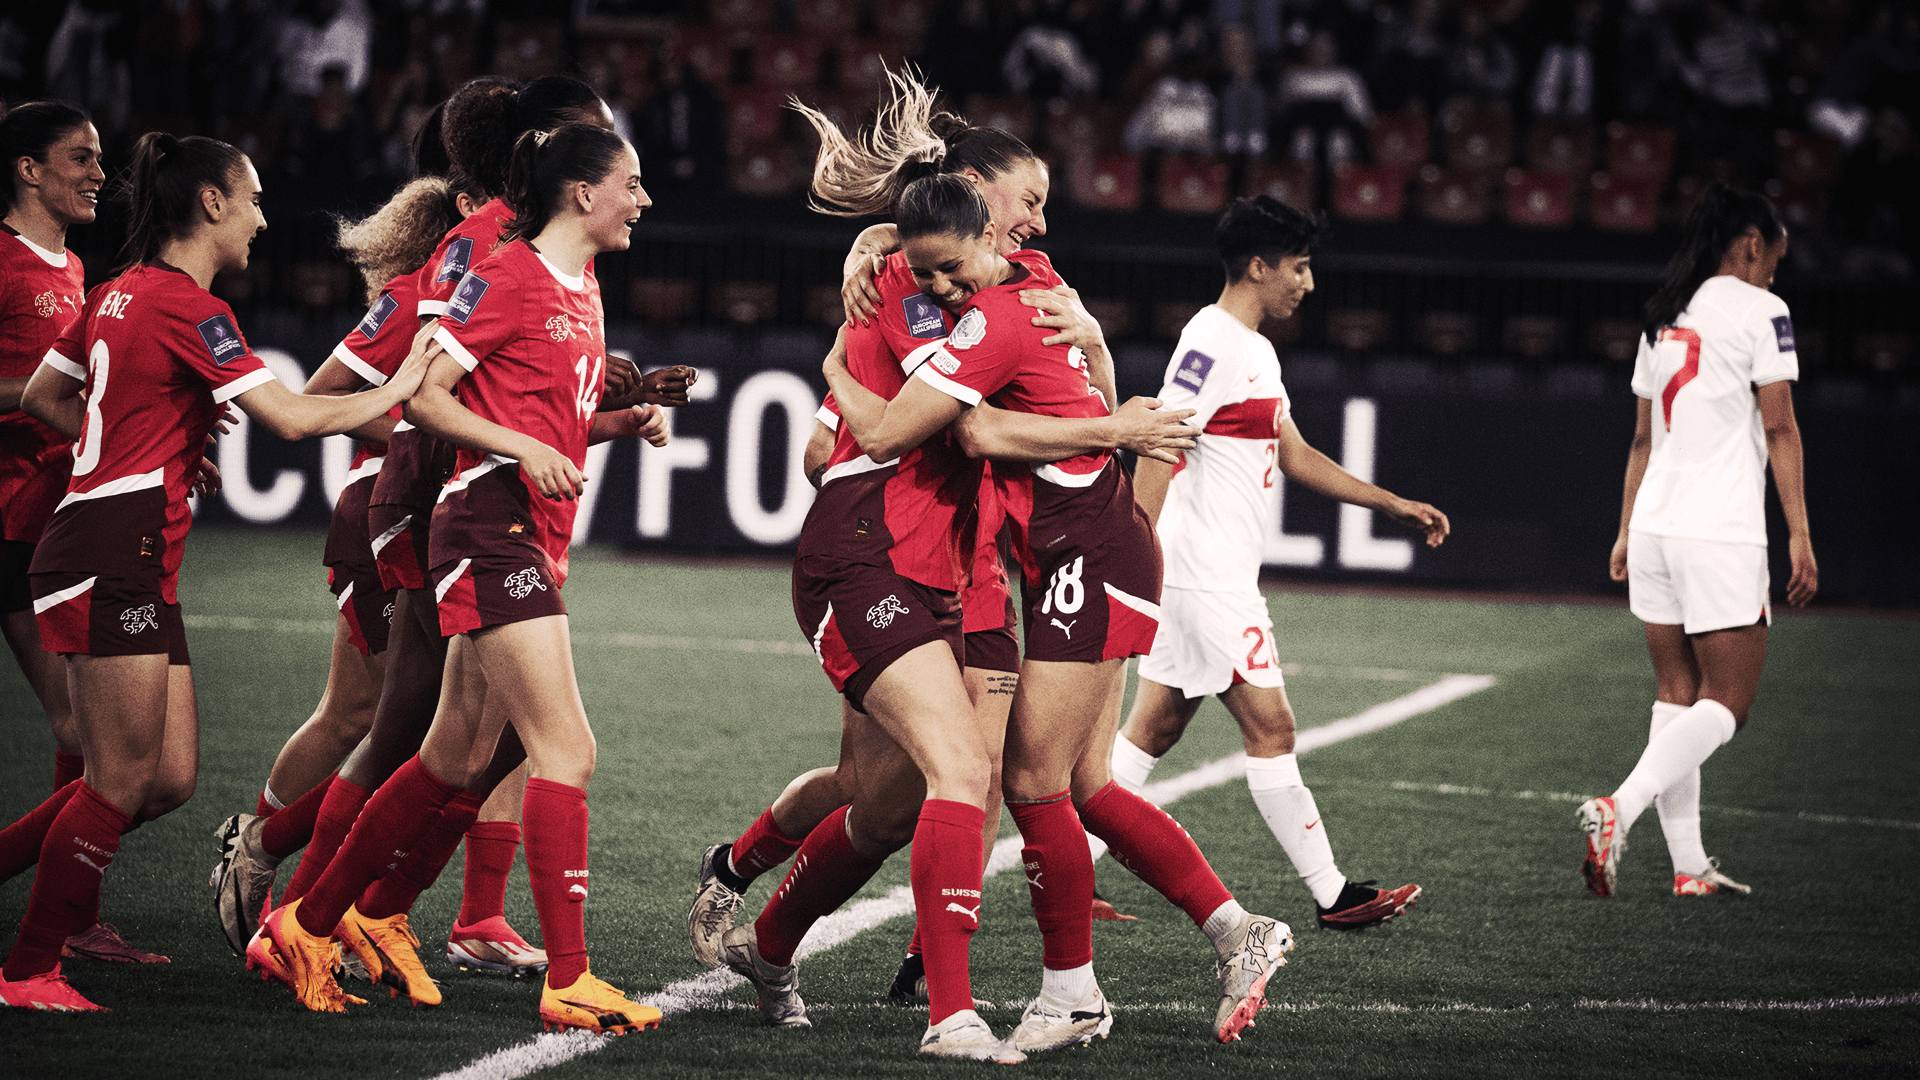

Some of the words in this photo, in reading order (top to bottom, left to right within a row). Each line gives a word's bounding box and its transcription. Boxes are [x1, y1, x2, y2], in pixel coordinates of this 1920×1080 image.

[575, 354, 602, 421] 14
[1659, 326, 1702, 433] 7
[1263, 442, 1276, 489] 2
[1041, 555, 1085, 614] 18
